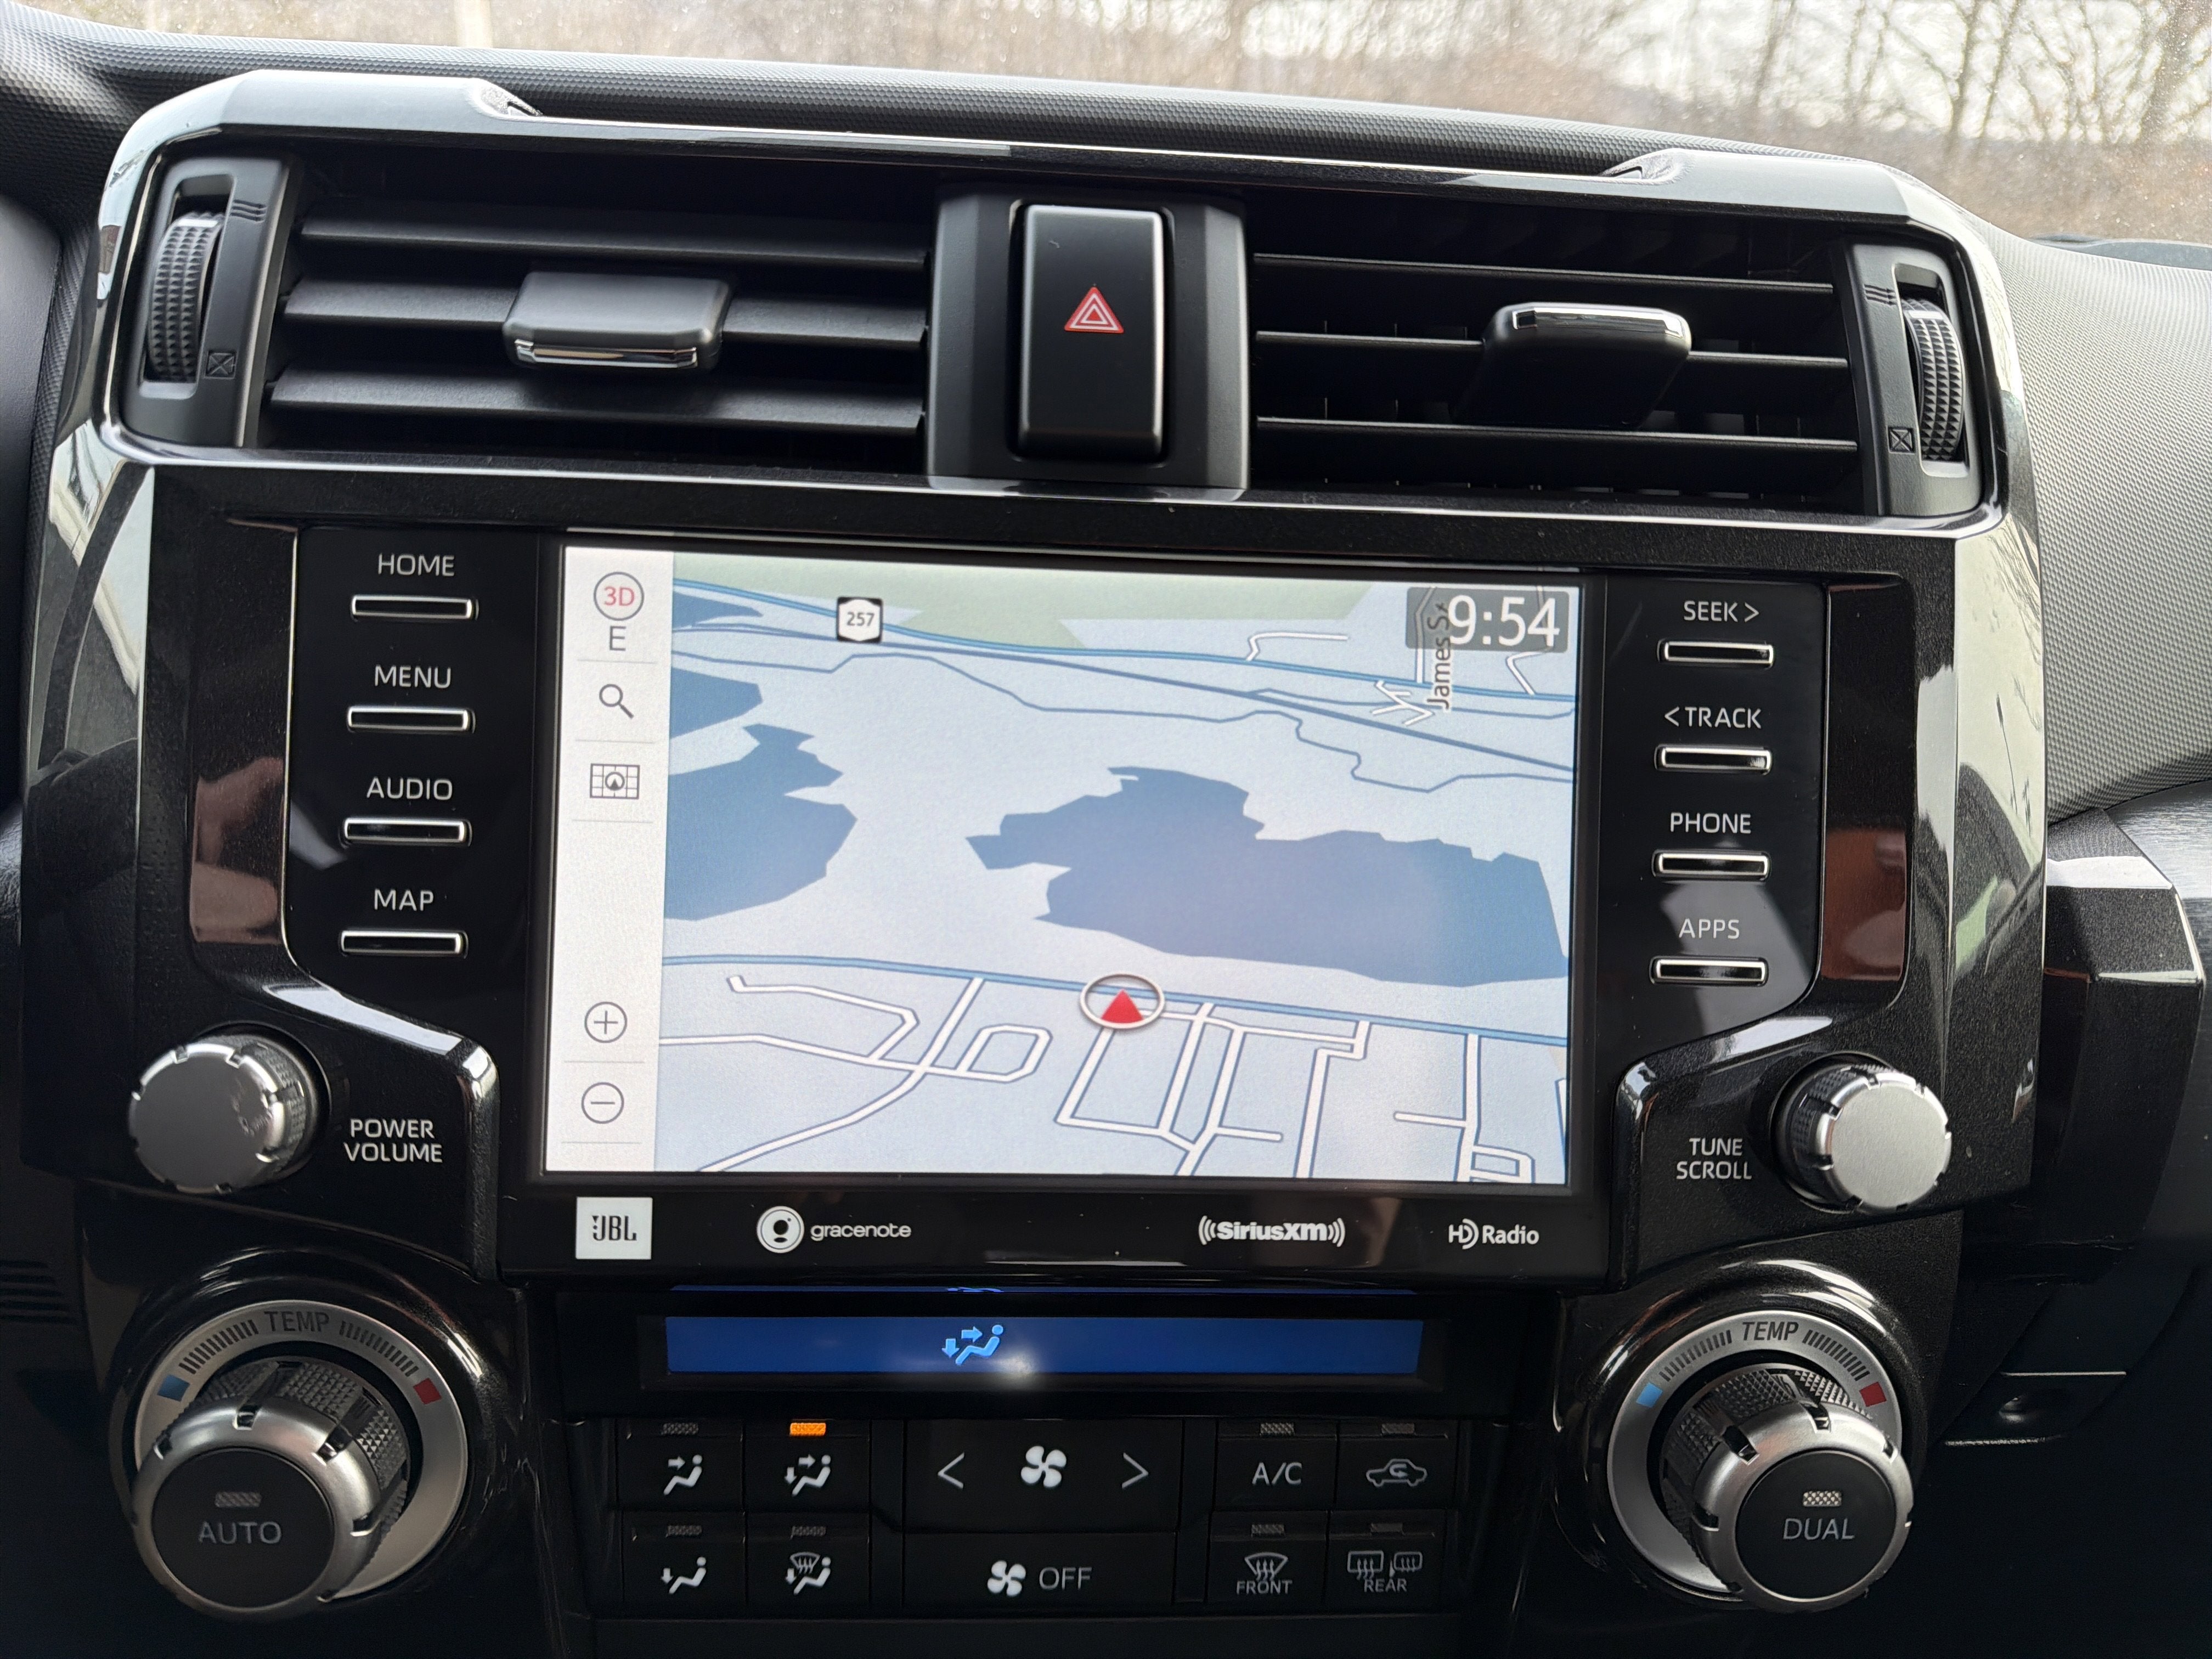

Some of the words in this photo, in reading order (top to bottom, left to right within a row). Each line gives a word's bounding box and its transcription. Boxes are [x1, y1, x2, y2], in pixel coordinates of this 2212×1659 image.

[377, 554, 455, 577] HOME
[603, 586, 635, 607] 3D
[847, 612, 875, 627] 257
[1448, 595, 1560, 647] 9:54
[609, 626, 627, 651] E
[374, 665, 452, 689] MENU
[1427, 636, 1451, 710] James
[366, 778, 453, 802] AUDIO
[1670, 813, 1752, 834] PHONE
[374, 889, 435, 912] MAP
[1679, 918, 1740, 939] APPS
[350, 1119, 435, 1139] POWER
[343, 1142, 443, 1163] VOLUME
[1689, 1137, 1743, 1156] TUNE
[1676, 1160, 1752, 1180] SCROLL
[591, 1215, 637, 1242] JBL
[810, 1223, 912, 1242] gracenote
[1482, 1224, 1539, 1245] Radio
[264, 1310, 329, 1333] TEMP
[1741, 1321, 1799, 1341] TEMP
[1252, 1462, 1302, 1486] A/C
[198, 1521, 282, 1544] AUTO
[1782, 1517, 1855, 1541] DUAL
[1039, 1567, 1092, 1591] OFF
[1236, 1580, 1293, 1595] FRONT
[1363, 1578, 1408, 1593] REAR
